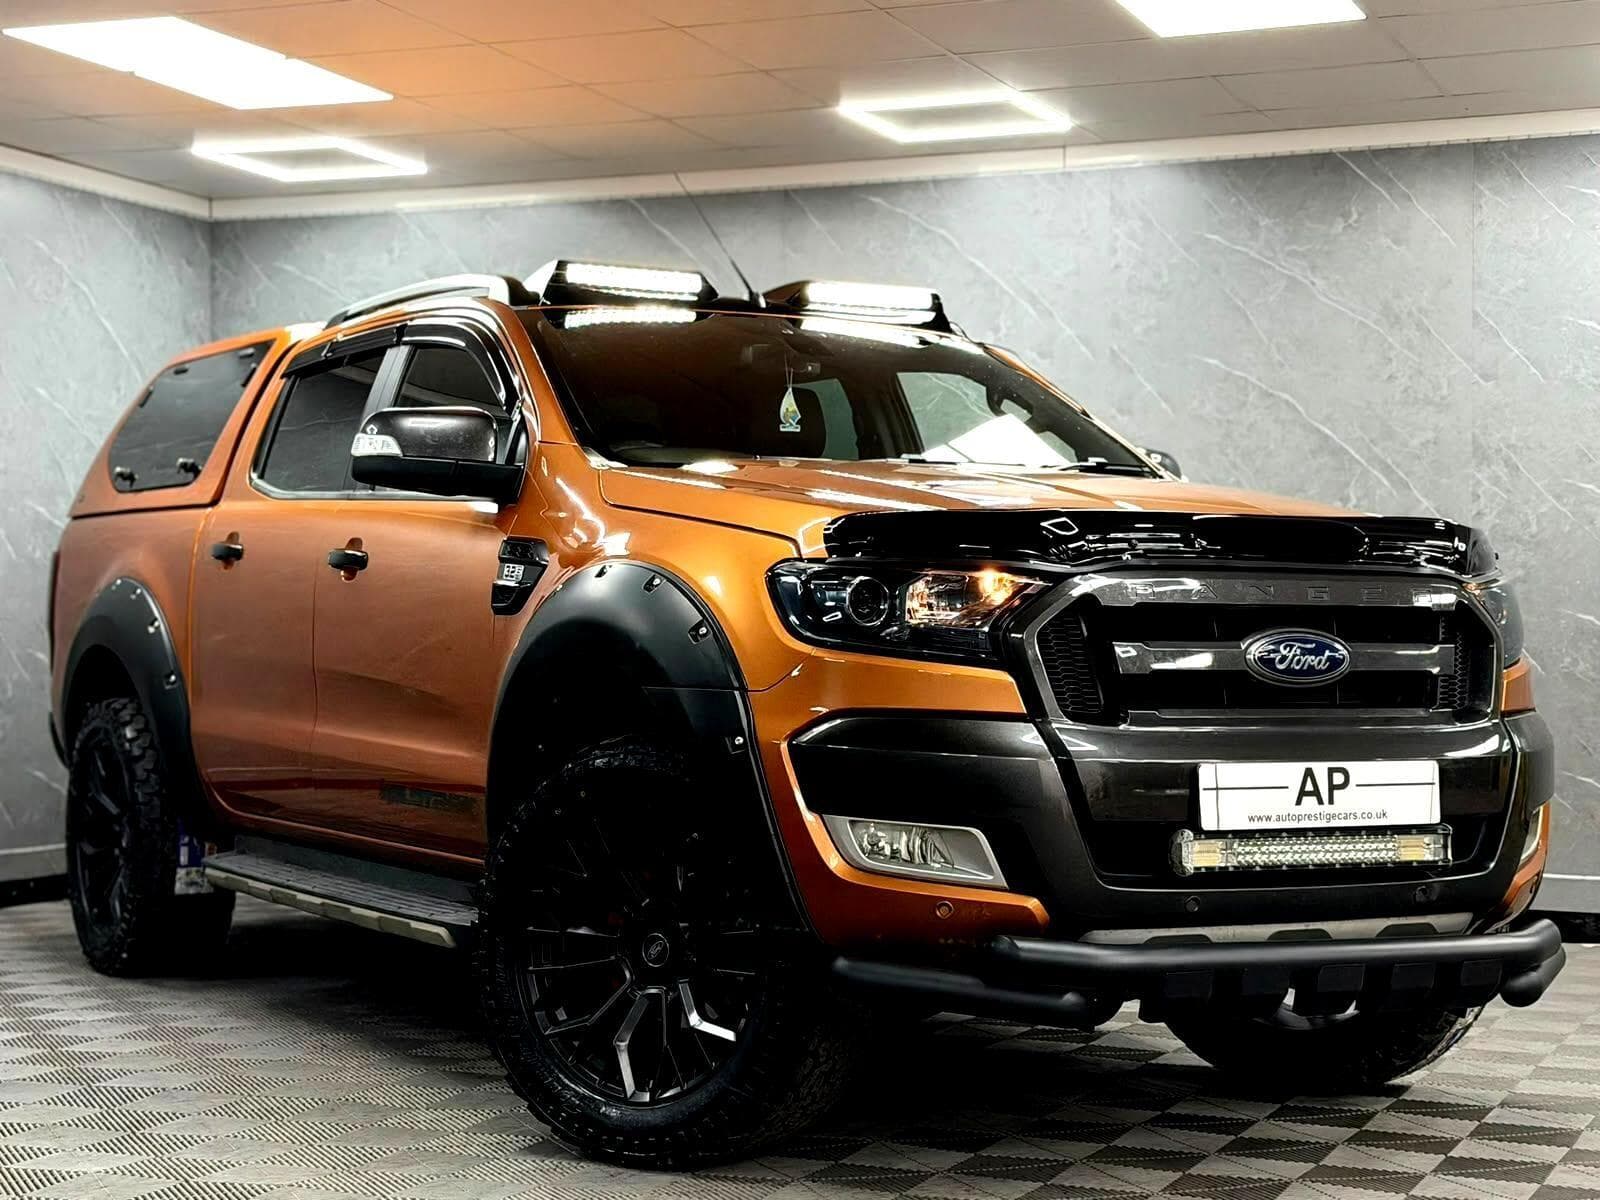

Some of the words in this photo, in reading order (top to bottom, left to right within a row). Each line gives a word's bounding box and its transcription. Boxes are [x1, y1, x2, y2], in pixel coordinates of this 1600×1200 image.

[1129, 582, 1434, 606] RANGER
[1275, 641, 1330, 670] Ford
[1294, 766, 1351, 806] AP
[1247, 809, 1389, 824] www.autoprestigecars.co.uk
